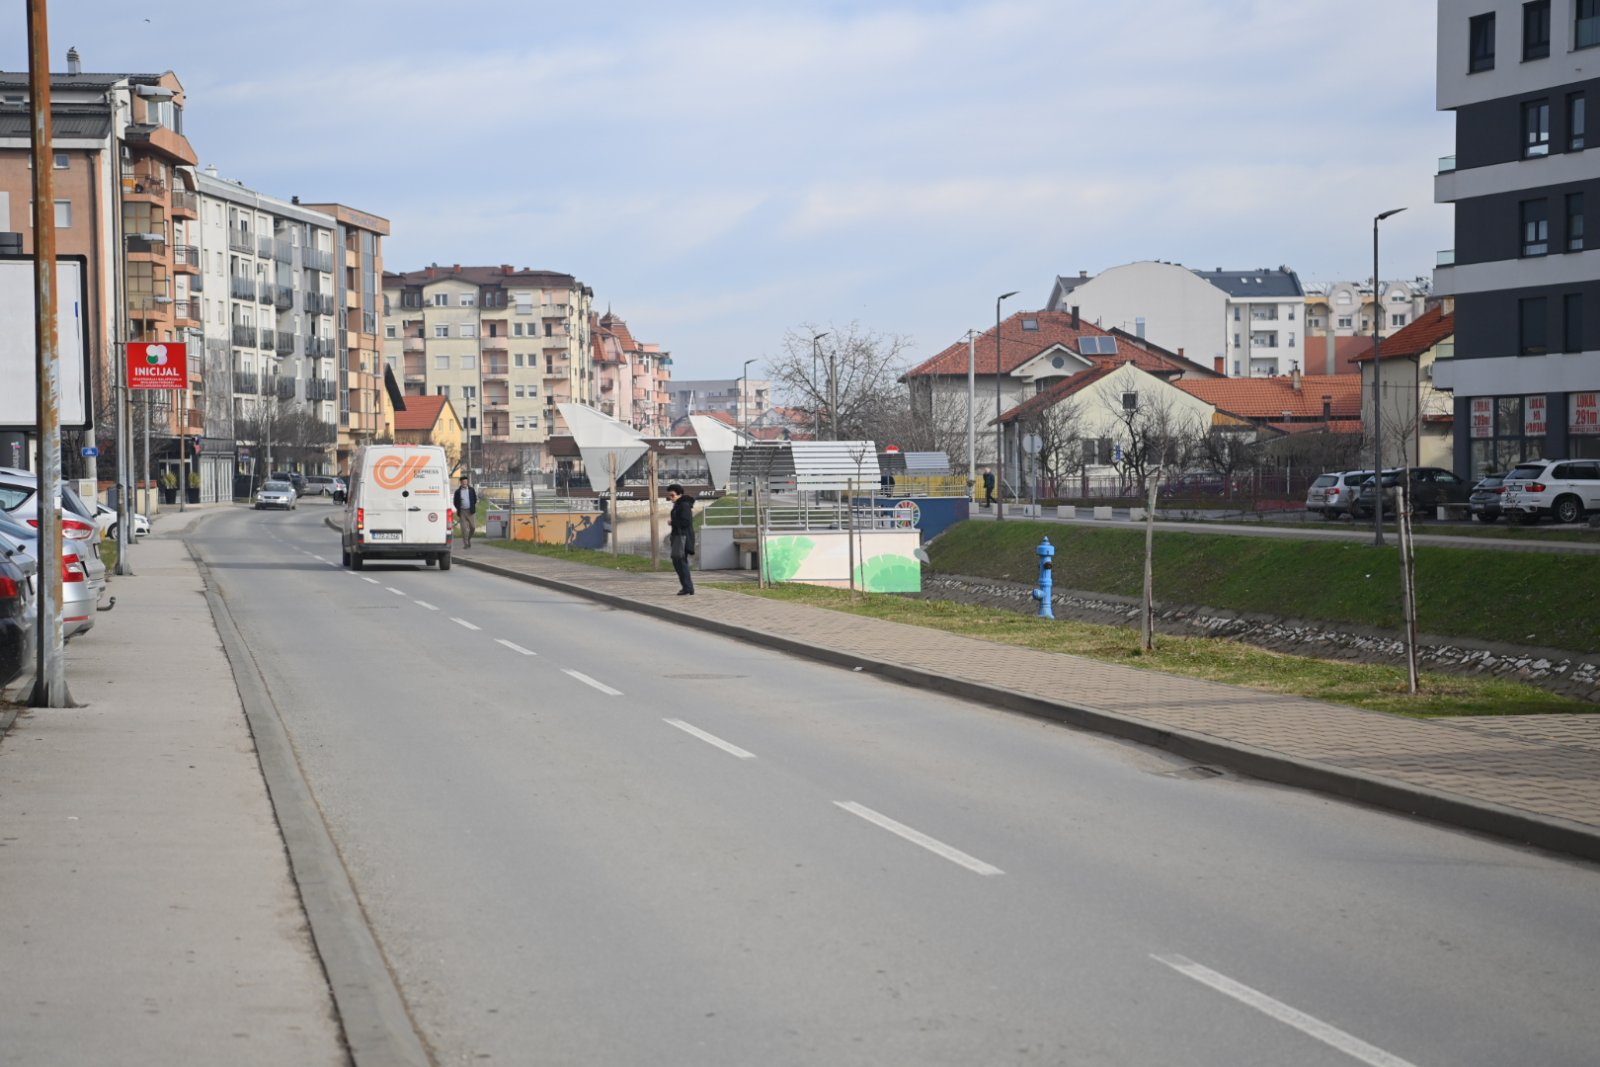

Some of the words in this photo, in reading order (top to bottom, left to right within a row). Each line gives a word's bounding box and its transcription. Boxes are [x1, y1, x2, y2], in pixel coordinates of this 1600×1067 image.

[134, 367, 180, 376] INICIJAL
[1530, 398, 1544, 409] LOKAL
[1576, 394, 1596, 408] LOKAL
